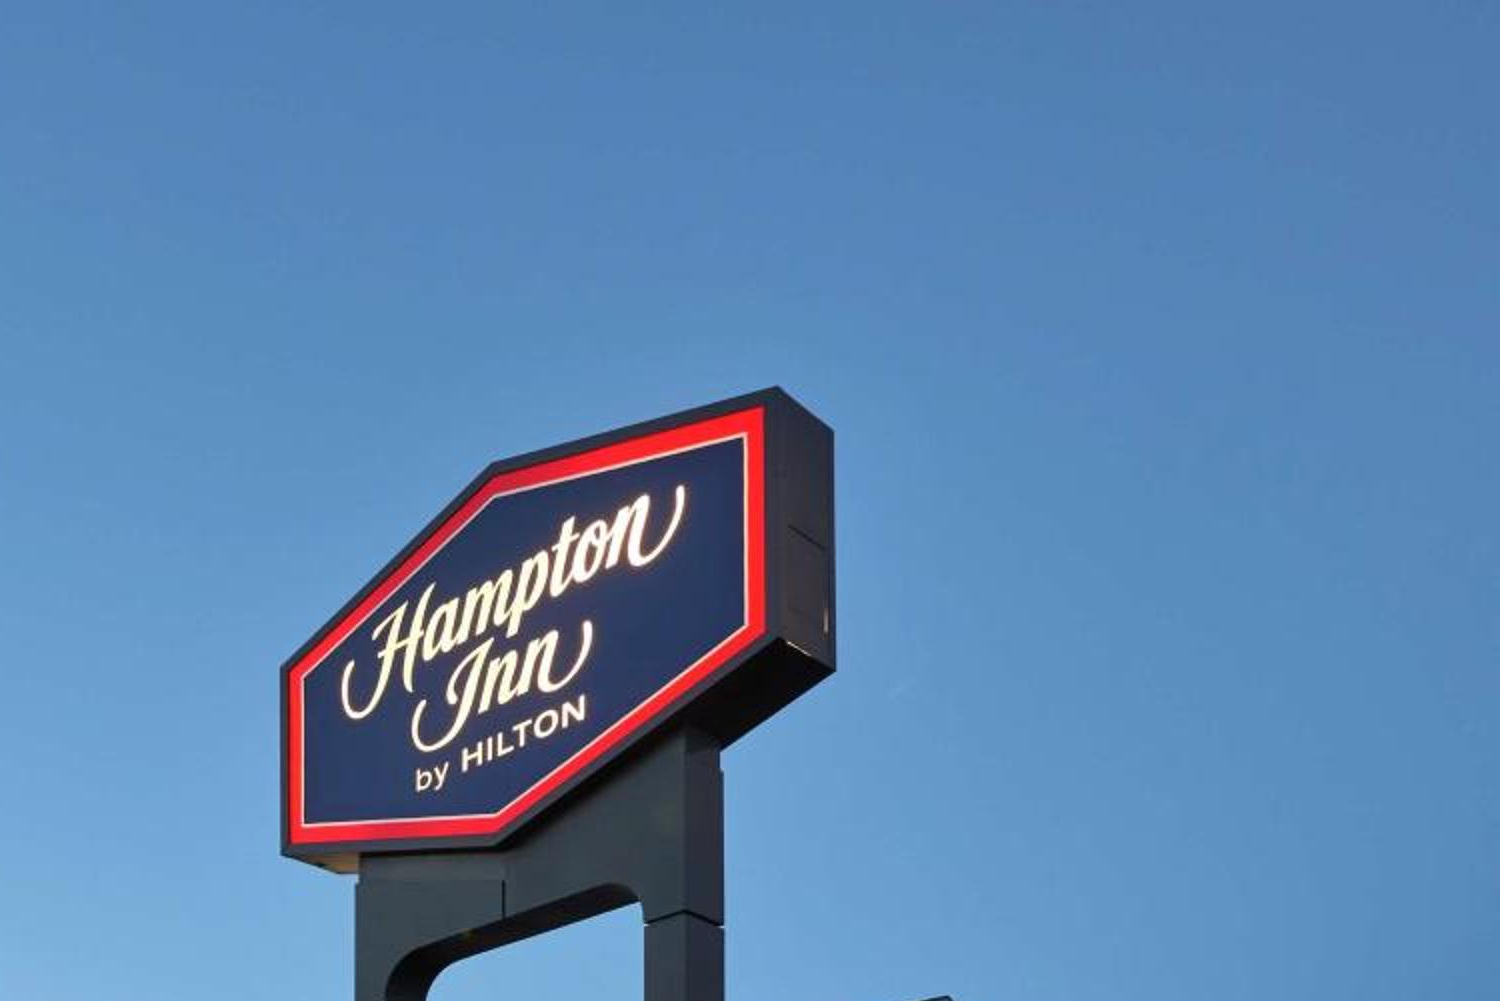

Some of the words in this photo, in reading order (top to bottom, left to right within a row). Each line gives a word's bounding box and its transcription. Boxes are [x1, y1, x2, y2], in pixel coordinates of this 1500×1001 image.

[340, 485, 686, 720] Hampton
[411, 620, 593, 753] Inn
[415, 762, 449, 792] by
[461, 694, 586, 773] HILTON
